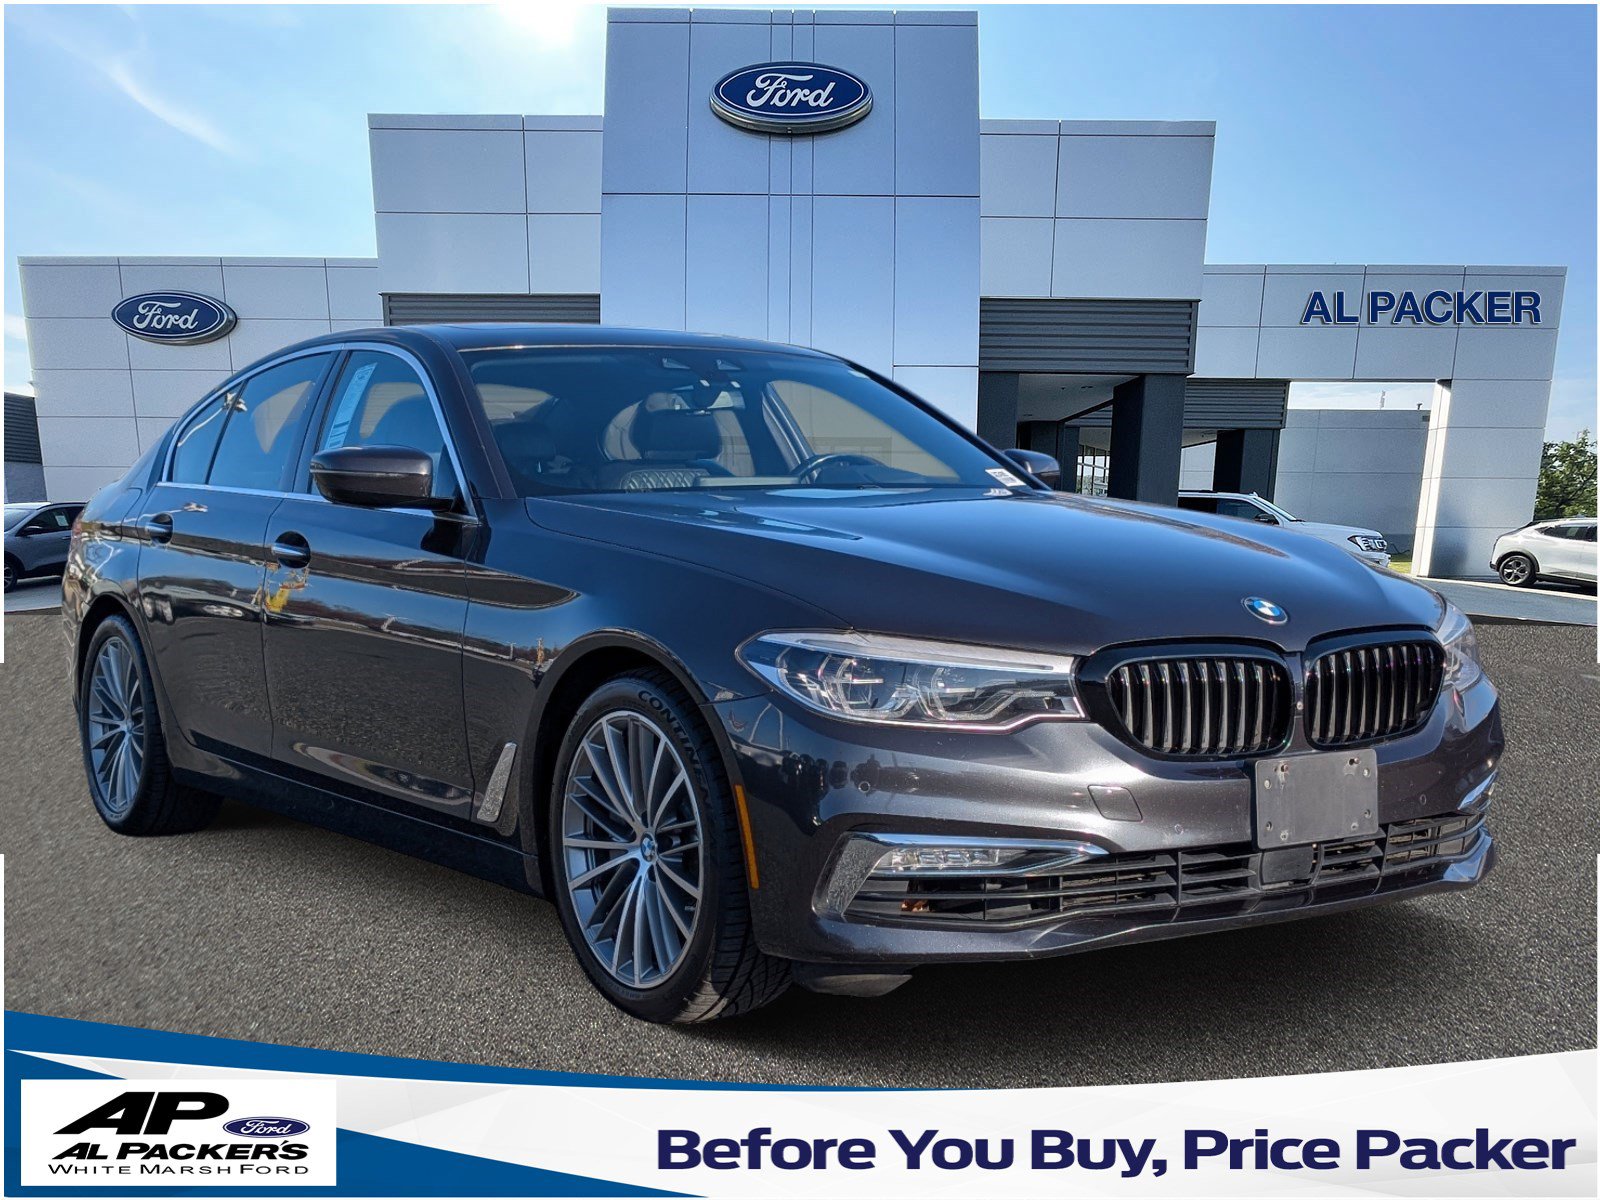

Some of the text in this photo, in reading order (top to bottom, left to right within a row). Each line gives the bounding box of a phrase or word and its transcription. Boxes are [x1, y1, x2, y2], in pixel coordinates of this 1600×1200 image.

[746, 73, 836, 107] Ford
[133, 301, 198, 329] Ford
[1301, 290, 1543, 325] AL PACKER
